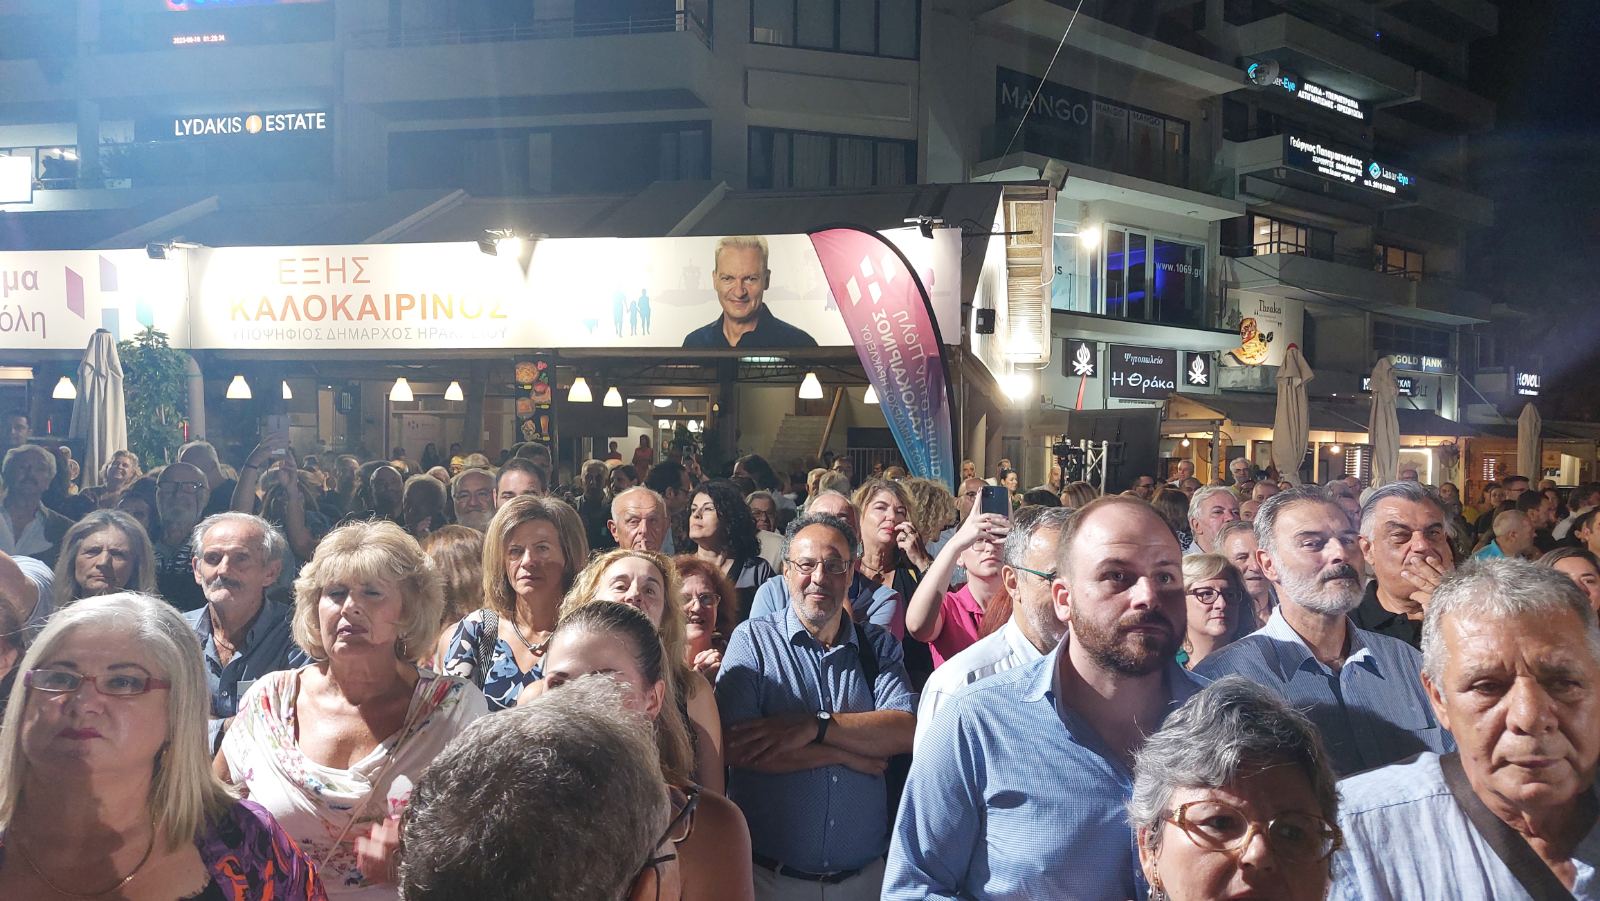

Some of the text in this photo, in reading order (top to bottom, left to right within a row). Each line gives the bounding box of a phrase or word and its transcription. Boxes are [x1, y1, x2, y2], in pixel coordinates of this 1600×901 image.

[1002, 82, 1088, 126] MANGO
[175, 113, 326, 136] LYDAKIS ESTATE
[279, 256, 371, 284] ΕΞΗΣ
[229, 293, 509, 322] ΚΑΛΟΚΑΙΡΙΝΟΣ
[326, 327, 413, 341] ΔΗΜΑΡΧΟΣ
[1396, 354, 1418, 366] GOLD
[1111, 371, 1175, 393] Η Θράκα
